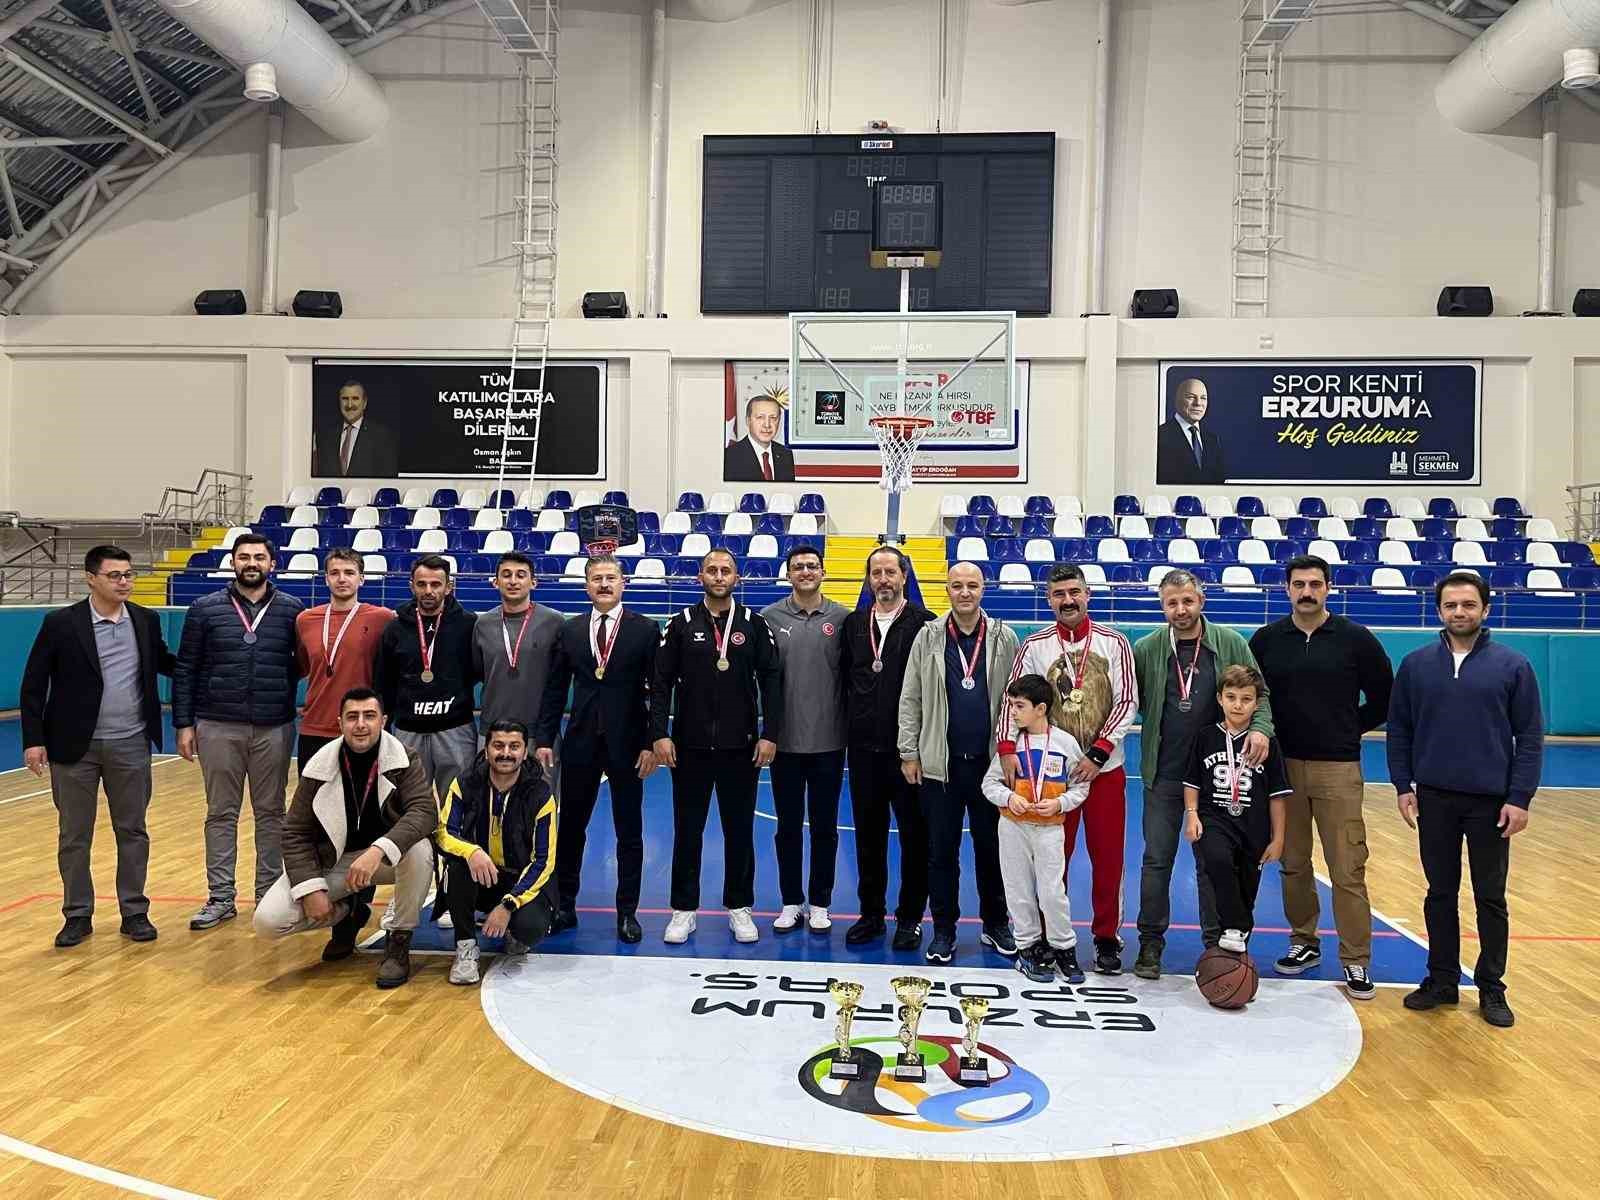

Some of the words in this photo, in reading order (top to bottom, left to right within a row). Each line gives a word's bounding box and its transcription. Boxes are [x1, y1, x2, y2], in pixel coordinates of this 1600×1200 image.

[480, 372, 512, 387] TÜM
[1272, 374, 1341, 394] SPOR
[1349, 370, 1423, 393] KENTİ
[438, 391, 555, 403] KATILIMCILARA
[965, 411, 996, 425] TBF
[464, 422, 529, 436] DİLERİM.
[1277, 422, 1319, 449] Hoş
[1326, 422, 1419, 446] Geldiniz
[501, 448, 522, 457] şkın
[1418, 462, 1459, 470] SEKMEN
[414, 696, 456, 715] HEAT
